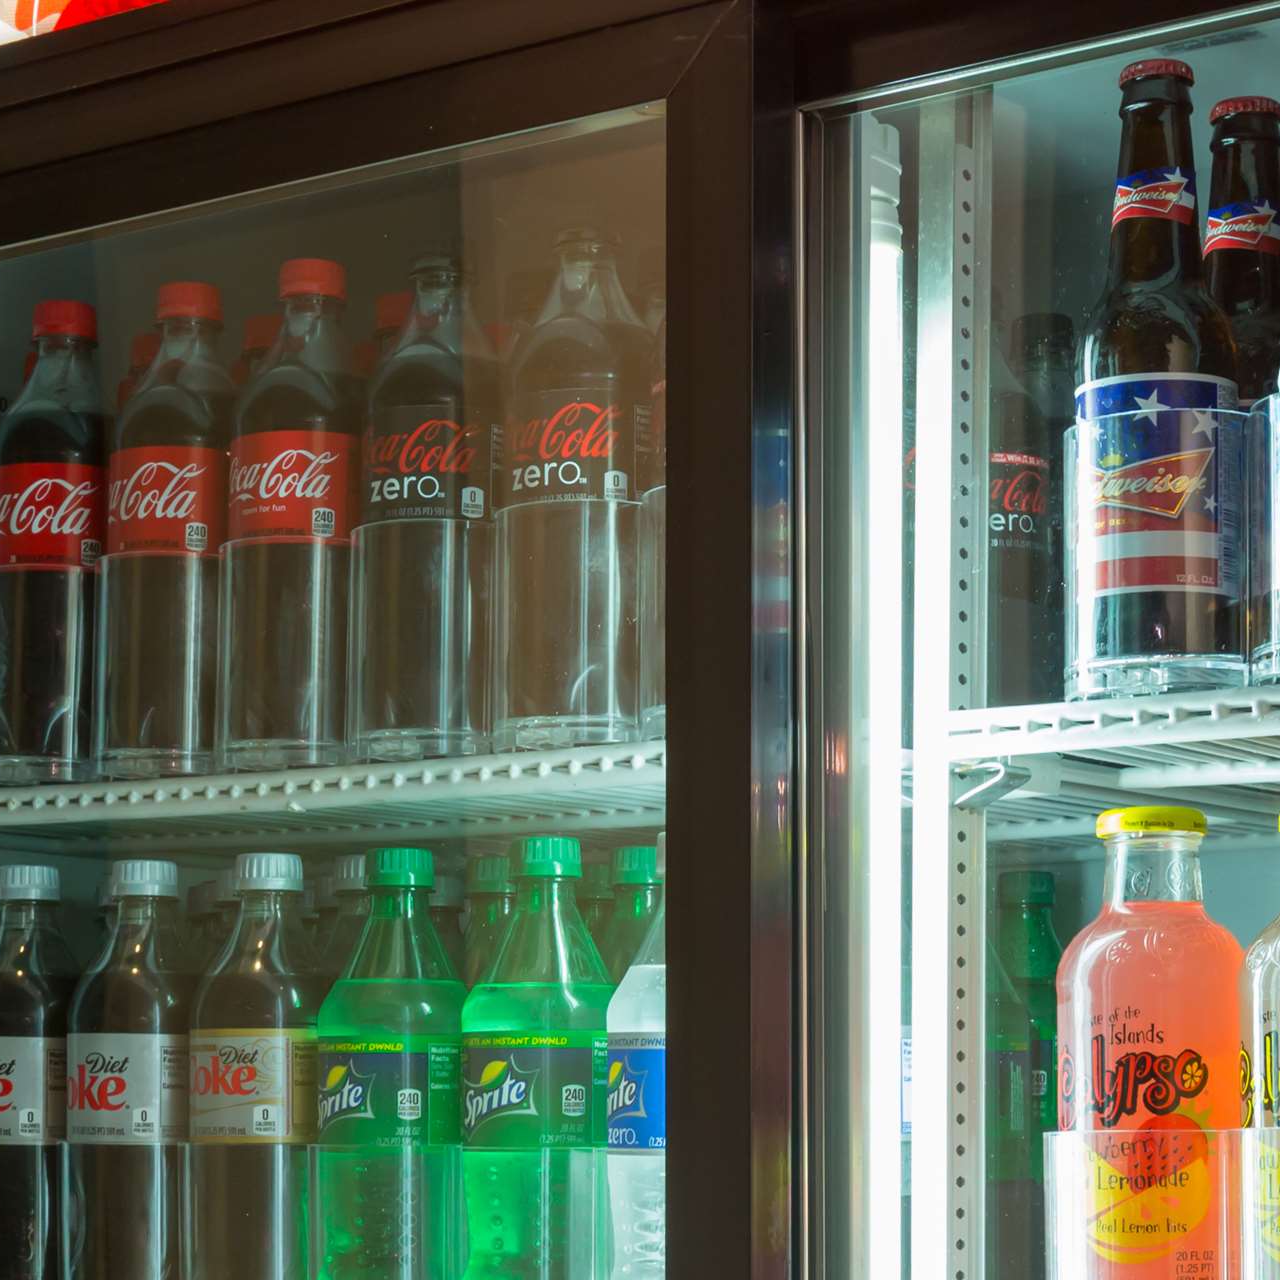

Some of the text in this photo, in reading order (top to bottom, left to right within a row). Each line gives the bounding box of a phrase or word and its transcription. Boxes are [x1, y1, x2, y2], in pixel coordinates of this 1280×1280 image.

[512, 461, 583, 492] zero
[370, 476, 440, 504] zero
[313, 510, 334, 525] 240
[187, 524, 208, 539] 240
[1108, 1007, 1120, 1024] of
[531, 1036, 568, 1046] DWNLD
[1109, 1023, 1165, 1046] Islands
[85, 1051, 130, 1074] Diet
[219, 1046, 259, 1065] Diet
[399, 1092, 420, 1106] 240
[463, 1077, 526, 1125] Sprite
[564, 1087, 585, 1102] 240
[27, 1111, 34, 1124] 0
[140, 1110, 148, 1123] 0
[1097, 1165, 1191, 1191] Lemonade
[1121, 1218, 1161, 1234] Lemon
[1175, 1250, 1215, 1262] 20 FL OZ
[1175, 1263, 1198, 1276] (1.25
